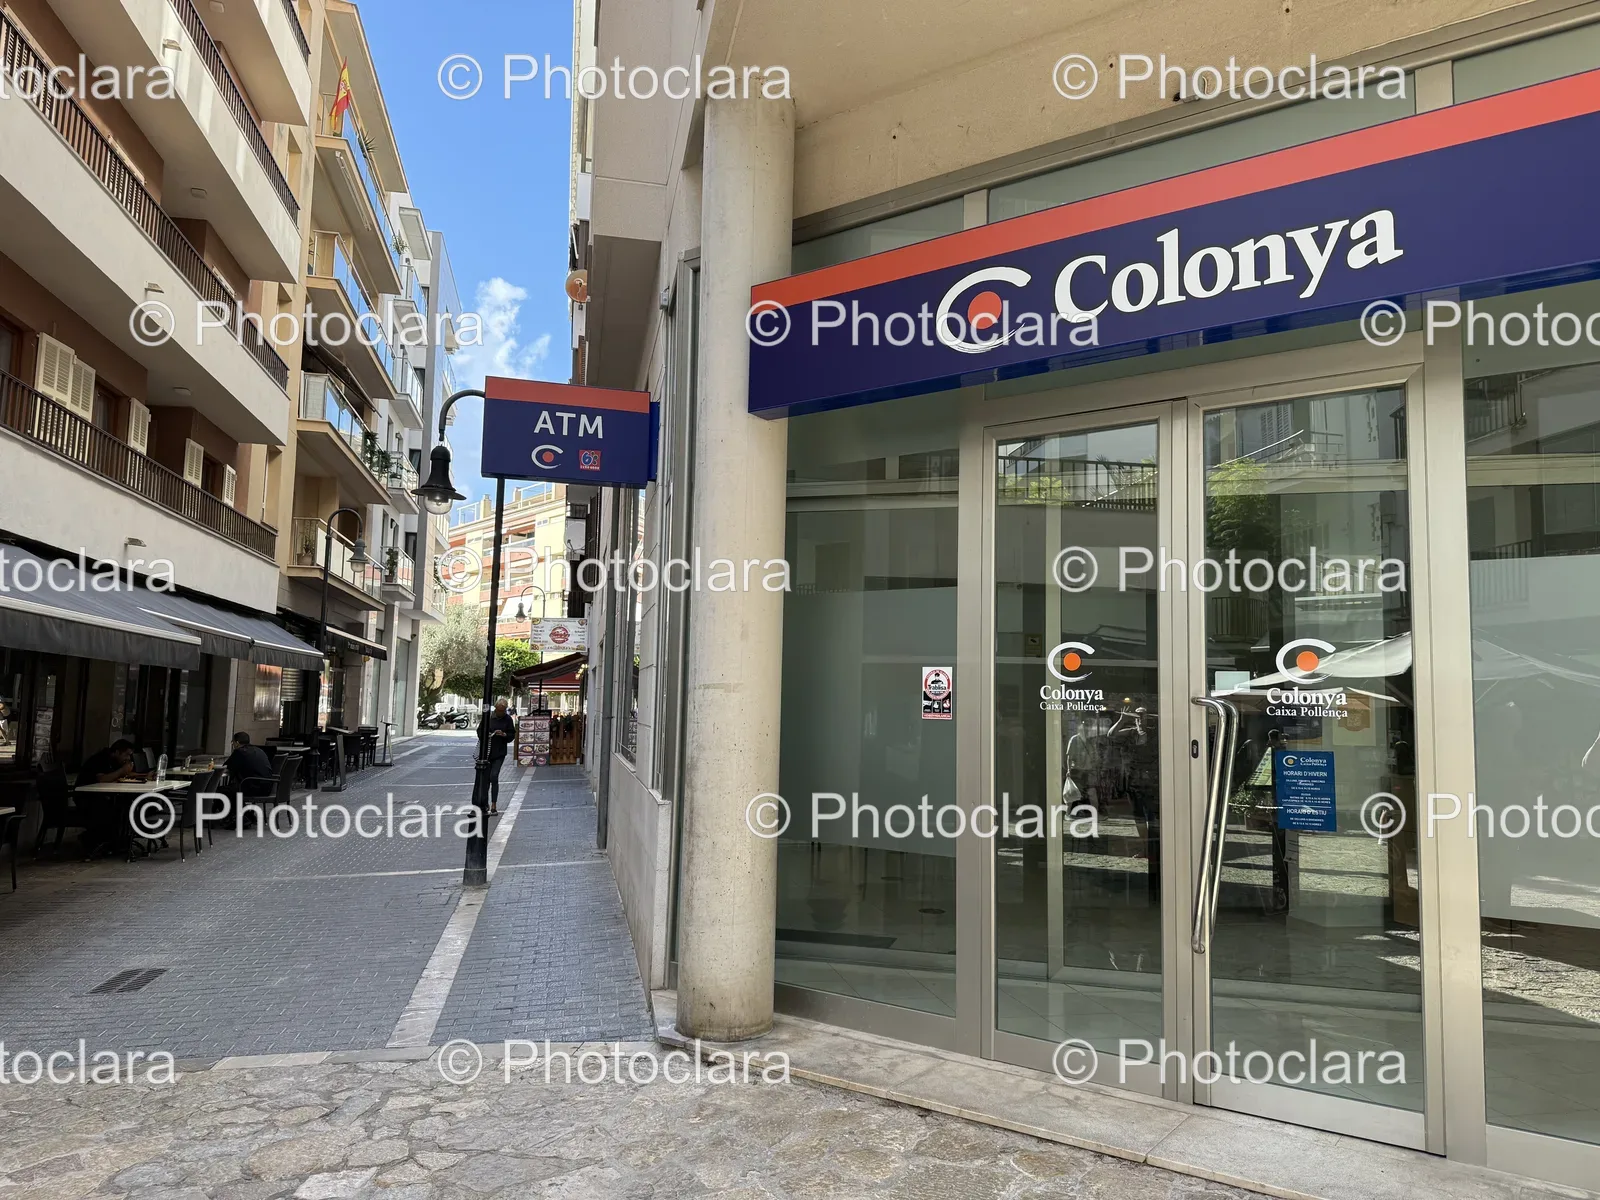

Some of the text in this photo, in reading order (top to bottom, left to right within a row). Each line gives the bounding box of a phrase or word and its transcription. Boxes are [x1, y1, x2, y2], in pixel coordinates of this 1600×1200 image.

[1054, 209, 1404, 323] Colonya
[533, 410, 603, 439] ATM
[1039, 684, 1104, 704] Colonya
[1266, 686, 1347, 709] Colonya
[1039, 701, 1104, 713] Caixa Pollença
[1266, 706, 1348, 719] Caixa Pollença
